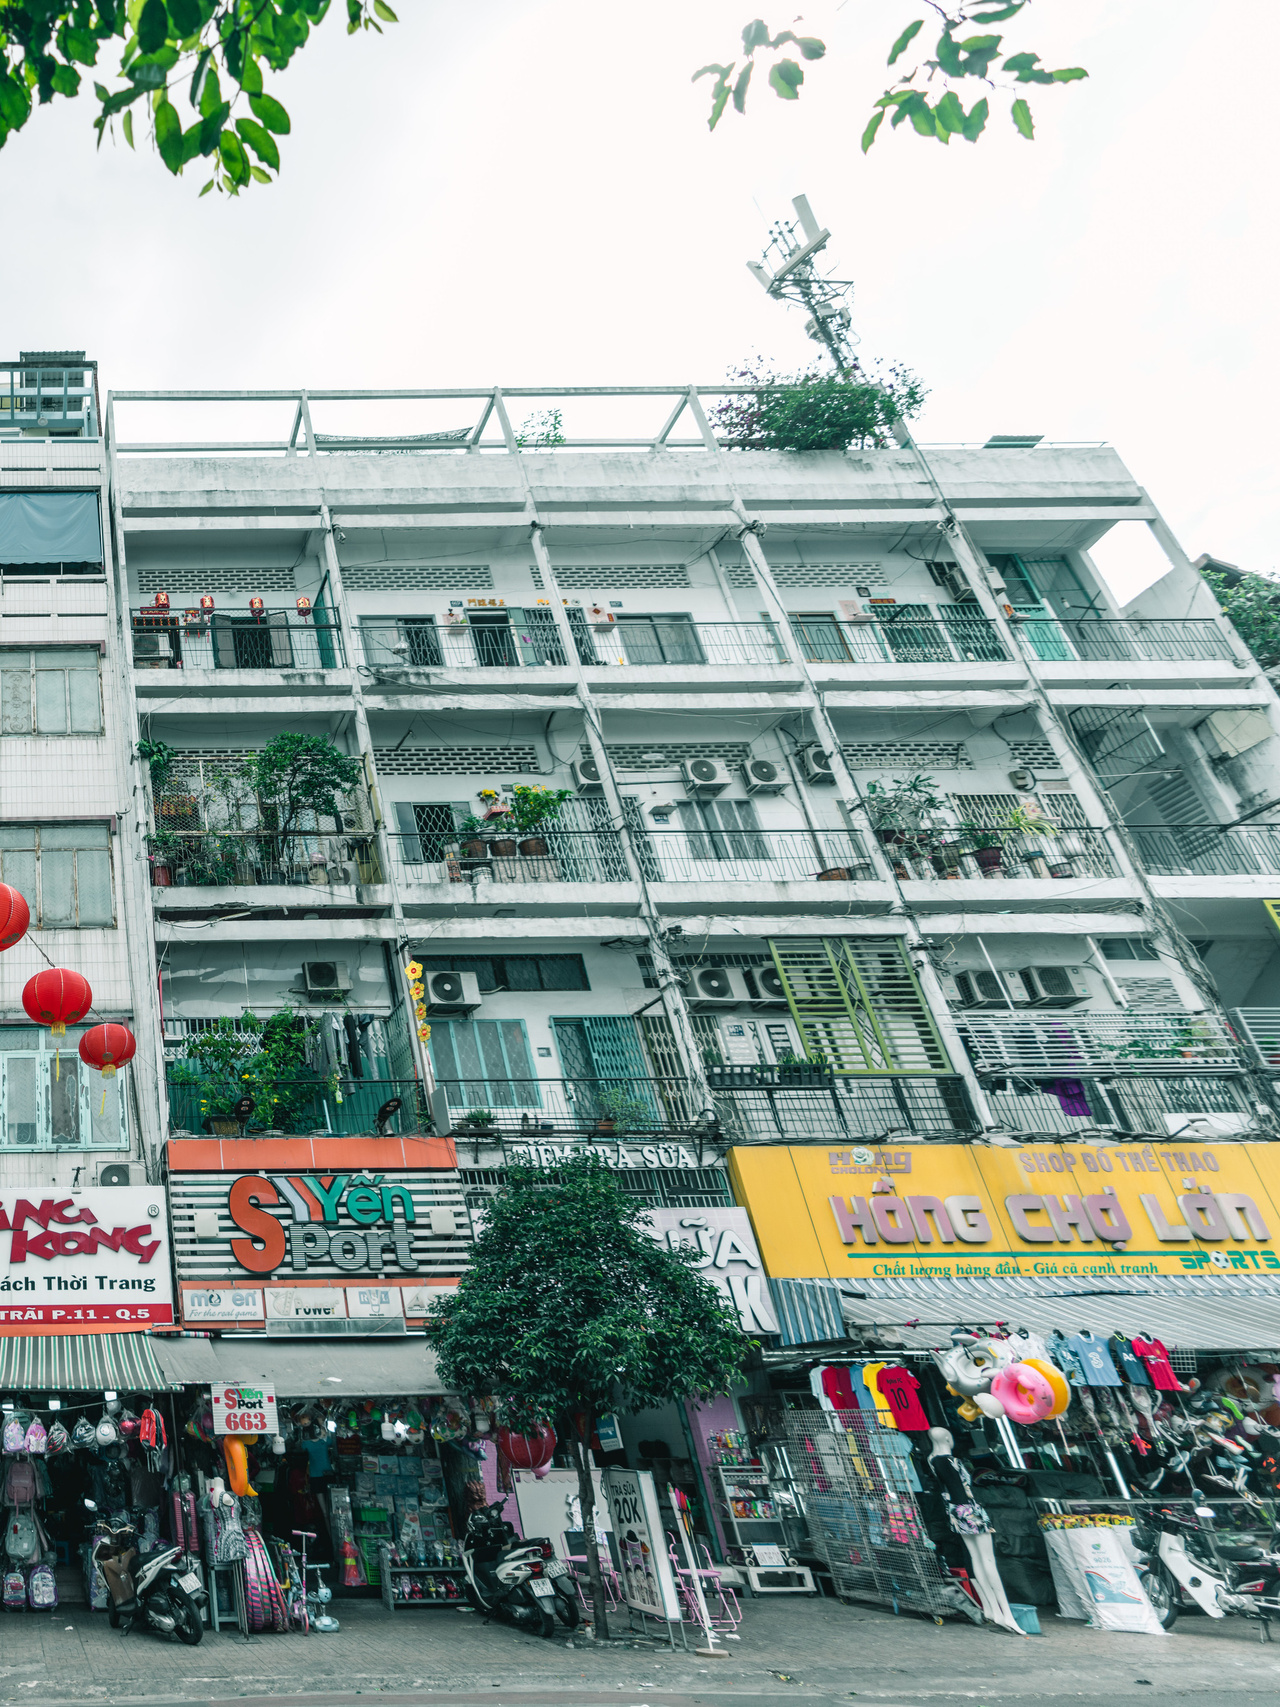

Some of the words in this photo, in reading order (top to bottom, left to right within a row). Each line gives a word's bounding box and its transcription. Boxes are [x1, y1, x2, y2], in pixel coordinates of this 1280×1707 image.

[641, 1143, 697, 1169] SỮA
[1020, 1152, 1077, 1173] SHOP
[1082, 1148, 1114, 1173] ĐỒ
[1115, 1144, 1161, 1172] THỂ
[1160, 1151, 1220, 1172] THAO
[830, 1166, 886, 1175] CHOLON
[828, 1175, 993, 1244] HỒNG
[1004, 1185, 1133, 1251] CHỢ
[1138, 1177, 1273, 1243] LỚN
[873, 1261, 906, 1276] Chất
[910, 1263, 952, 1278] lượng
[955, 1262, 993, 1278] hàng
[995, 1261, 1021, 1276] đầu
[1033, 1260, 1059, 1275] Giá
[1062, 1262, 1078, 1275] cả
[1080, 1262, 1116, 1277] cạnh
[1120, 1263, 1159, 1275] tranh
[1179, 1250, 1280, 1270] SPRTS
[43, 1274, 88, 1291] Thời
[95, 1275, 156, 1293] Trang
[51, 1309, 98, 1320] P.11
[115, 1308, 150, 1321] Q.5
[189, 1309, 204, 1318] For
[204, 1309, 218, 1317] the
[219, 1309, 235, 1317] real
[235, 1310, 258, 1319] game
[890, 1387, 910, 1412] 10
[225, 1412, 268, 1431] 663
[614, 1497, 643, 1524] 20K
